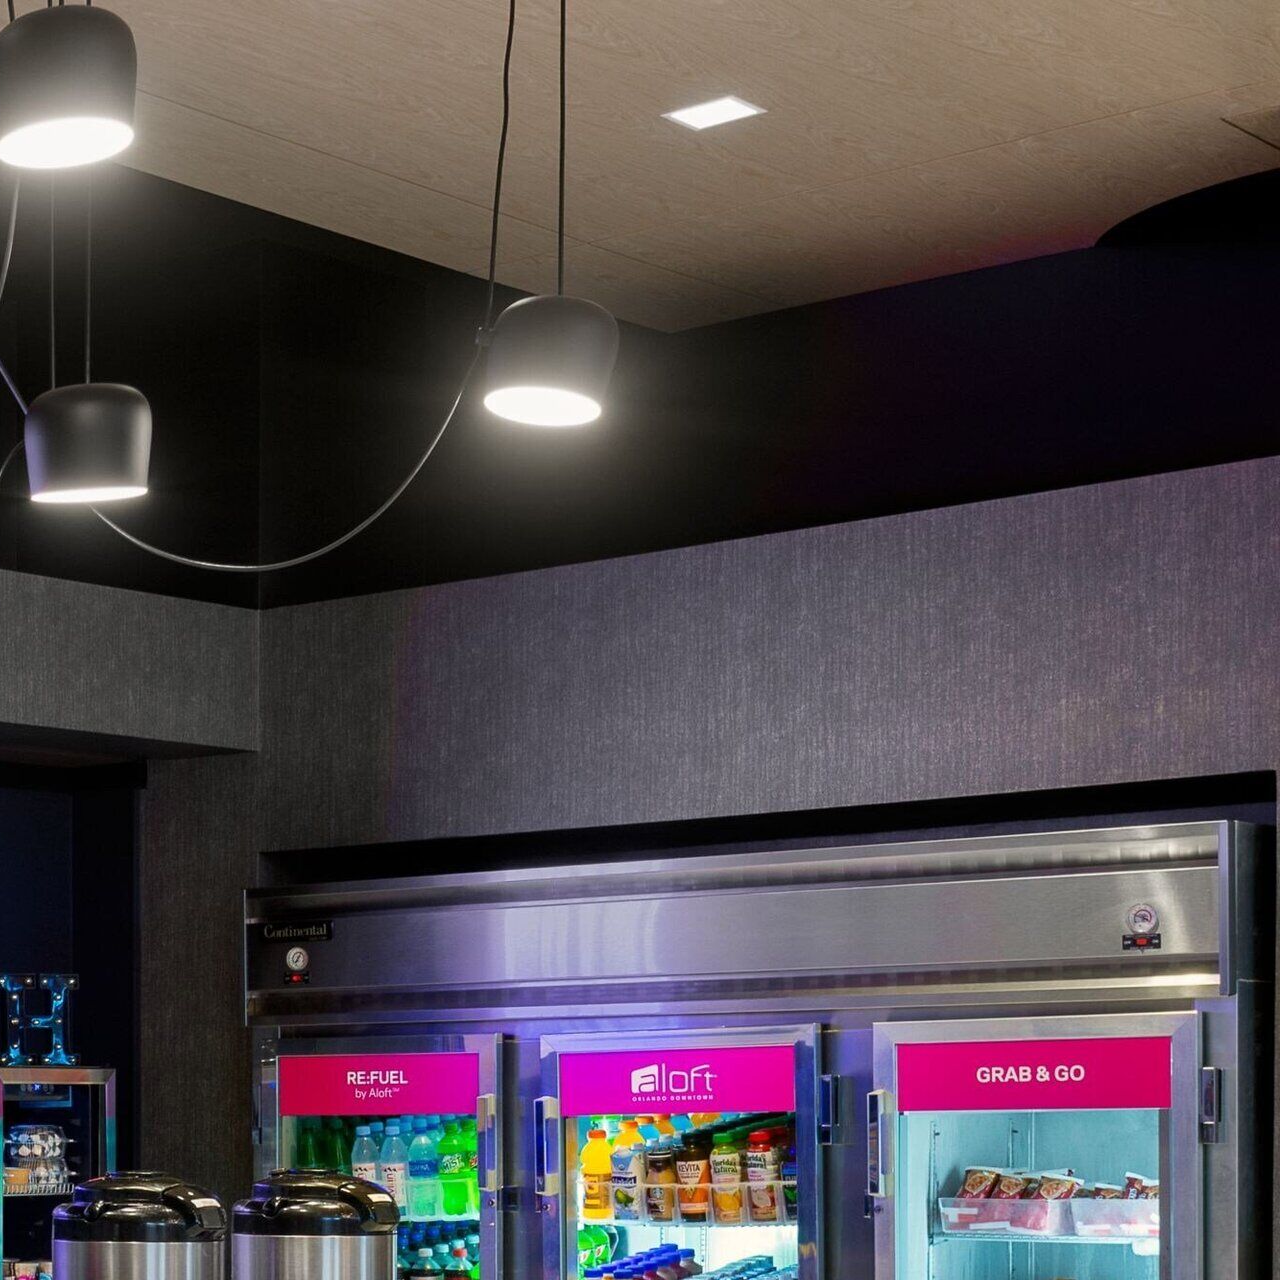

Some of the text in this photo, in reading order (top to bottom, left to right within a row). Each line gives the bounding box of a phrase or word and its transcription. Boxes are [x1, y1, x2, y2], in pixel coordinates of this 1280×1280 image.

[263, 923, 327, 938] Continental
[346, 1070, 408, 1085] RE:FUEL
[630, 1063, 717, 1094] aloft
[976, 1064, 1085, 1083] GRAB & GO
[355, 1088, 367, 1100] by
